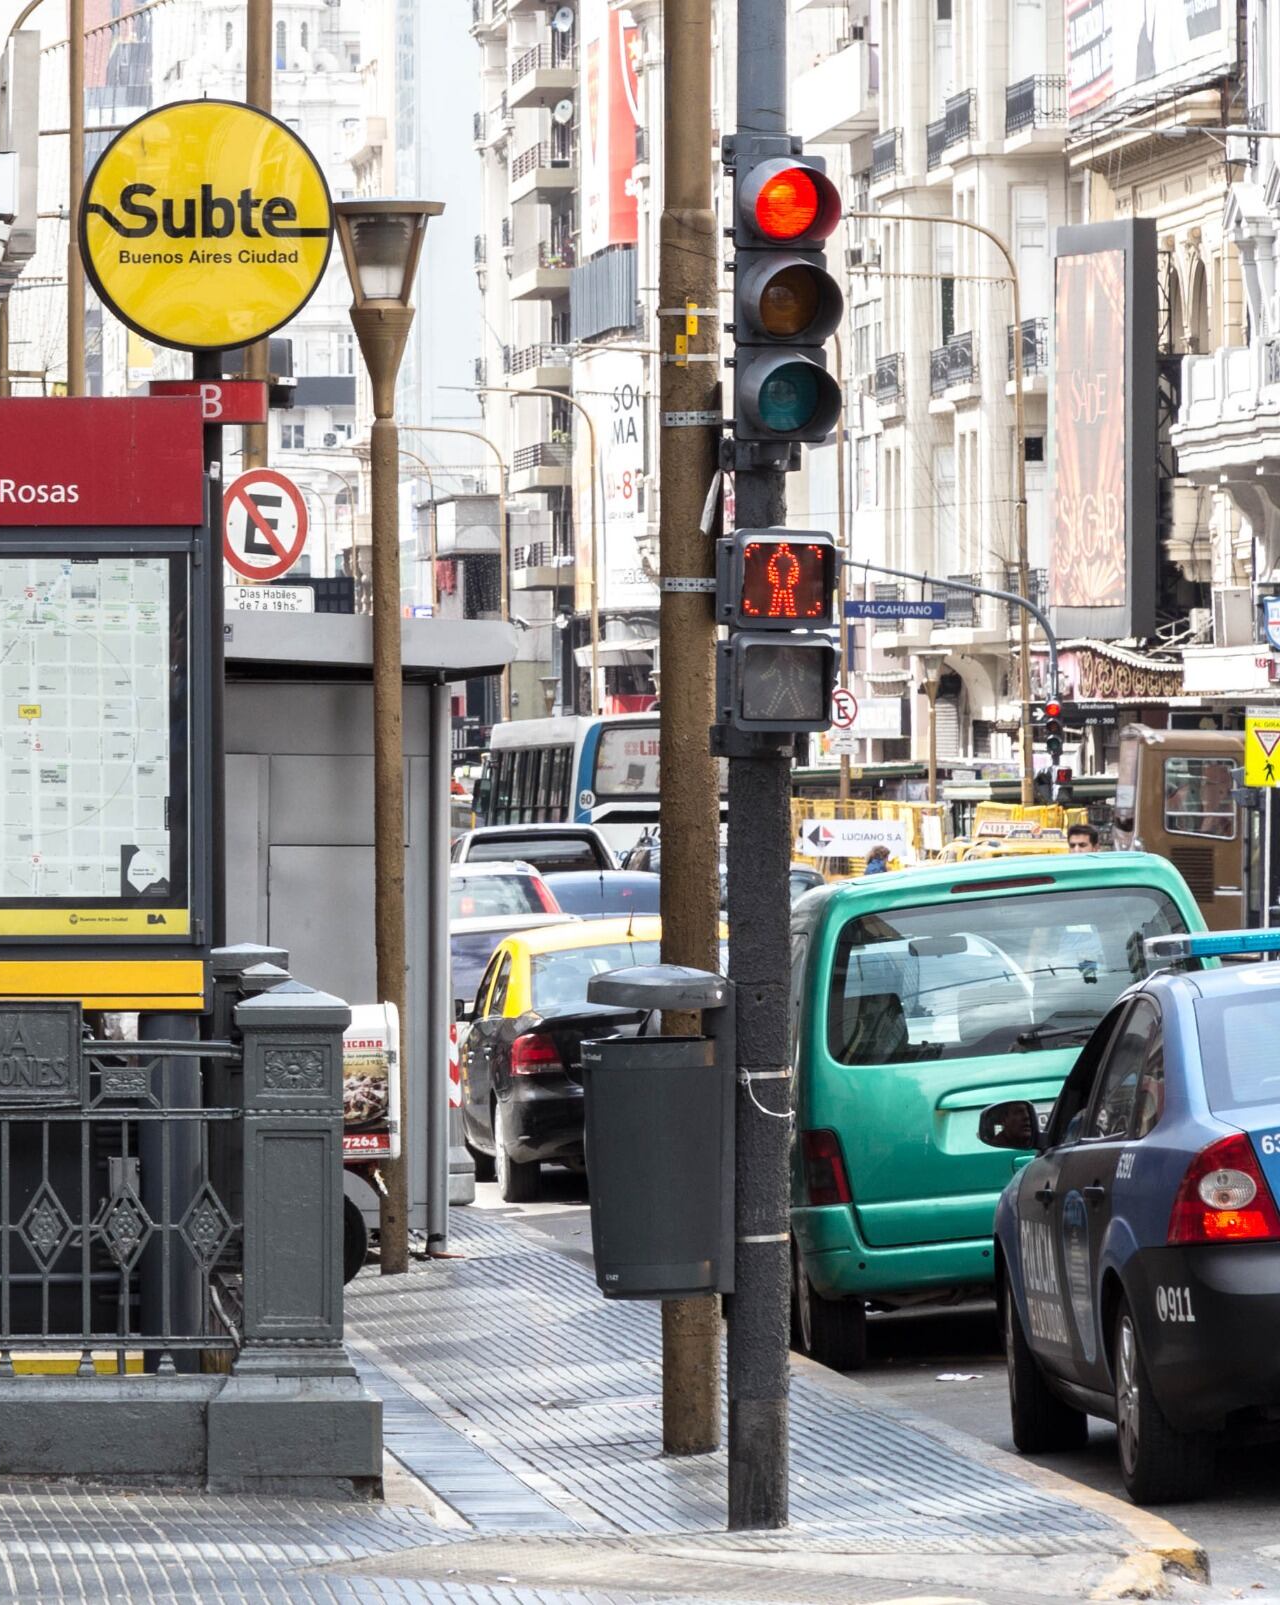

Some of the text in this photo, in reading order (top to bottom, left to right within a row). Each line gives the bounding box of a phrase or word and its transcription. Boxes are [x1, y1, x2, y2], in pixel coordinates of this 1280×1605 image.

[119, 183, 298, 238] Subte
[119, 249, 299, 264] Buenos Aires Ciudad
[200, 383, 223, 419] B
[0, 479, 79, 503] Rosas
[244, 494, 282, 556] E
[858, 604, 932, 616] TALCAHUANO
[580, 793, 592, 805] 60
[841, 832, 885, 841] LUCIANO
[343, 1136, 379, 1149] 7264
[1116, 1152, 1136, 1180] 6391
[1169, 1286, 1196, 1323] 911
